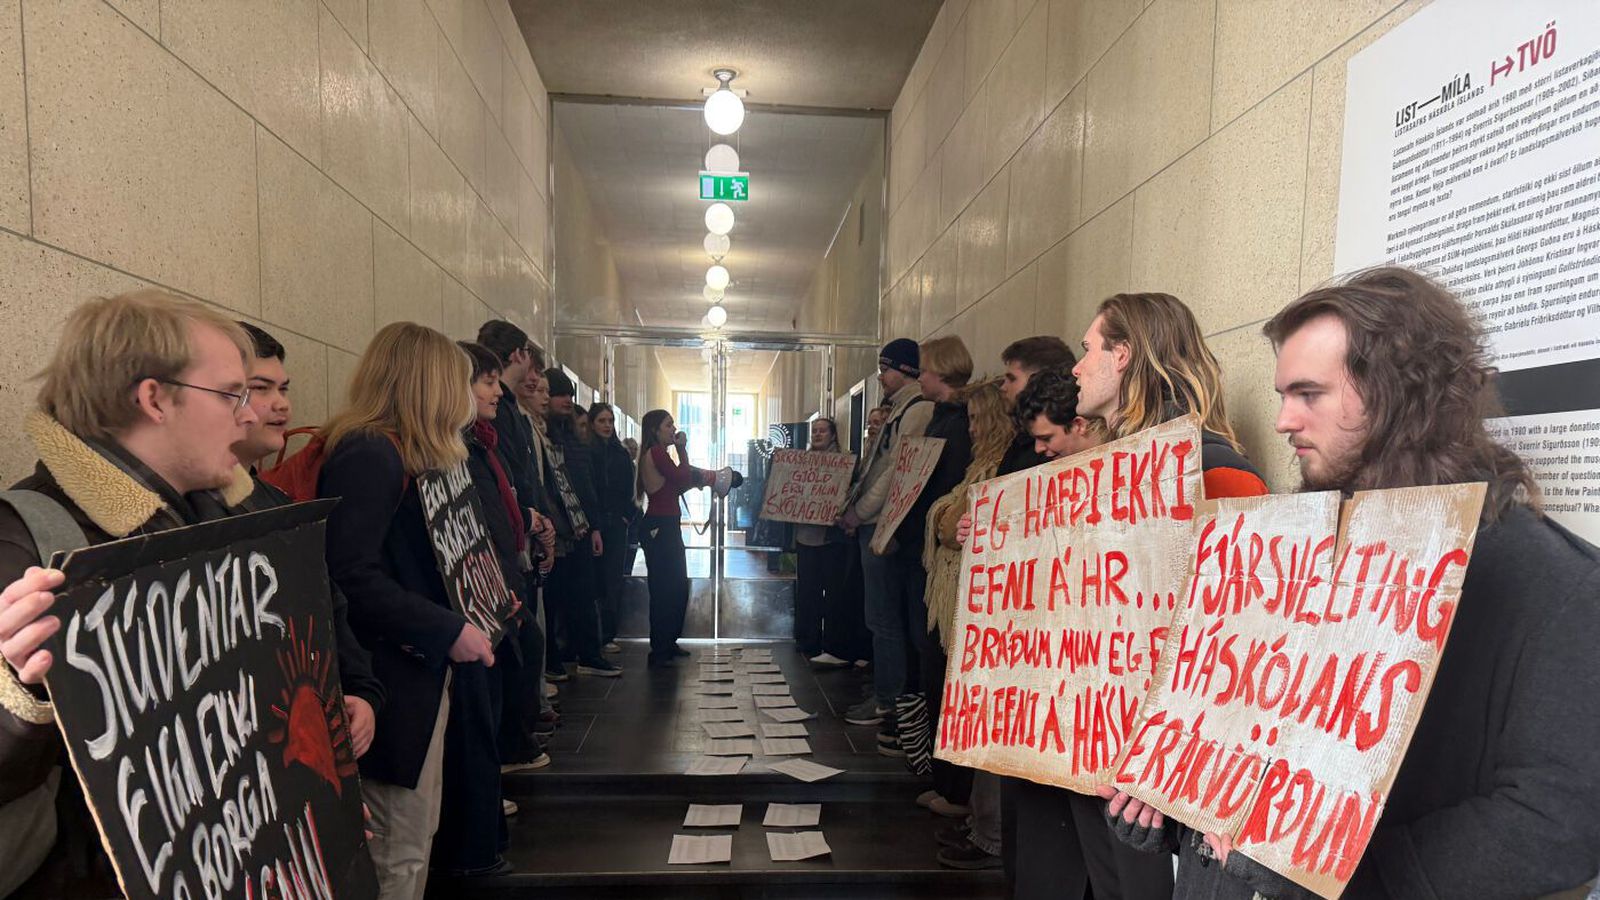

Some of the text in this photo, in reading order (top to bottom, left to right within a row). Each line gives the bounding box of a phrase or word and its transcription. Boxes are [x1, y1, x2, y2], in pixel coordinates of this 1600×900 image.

[1518, 20, 1556, 72] TVÖ
[1457, 86, 1484, 105] ÍSLANDS
[1528, 425, 1541, 435] with
[1550, 424, 1567, 435] large
[1582, 438, 1600, 449] (190
[1536, 455, 1568, 466] supported
[1571, 455, 1581, 464] the
[1561, 471, 1568, 480] of
[972, 485, 1009, 554] ÉG
[1024, 458, 1104, 538] HAFÐI
[1112, 439, 1193, 525] EKKI
[1553, 487, 1563, 496] the
[1565, 487, 1579, 496] New
[968, 558, 1038, 615] EFNI
[1048, 547, 1071, 611] Á
[1188, 512, 1468, 651] FJÁRSVELTING
[66, 552, 286, 760] STÚDENTAR
[961, 620, 1052, 673] BRÁÐUM
[1058, 629, 1102, 673] MUN
[1108, 615, 1142, 676] ÉG
[1172, 618, 1421, 751] HÁSKÓLANS
[197, 668, 258, 799] EKKI
[941, 680, 1140, 776] HAFA EFNI Á HÁSK
